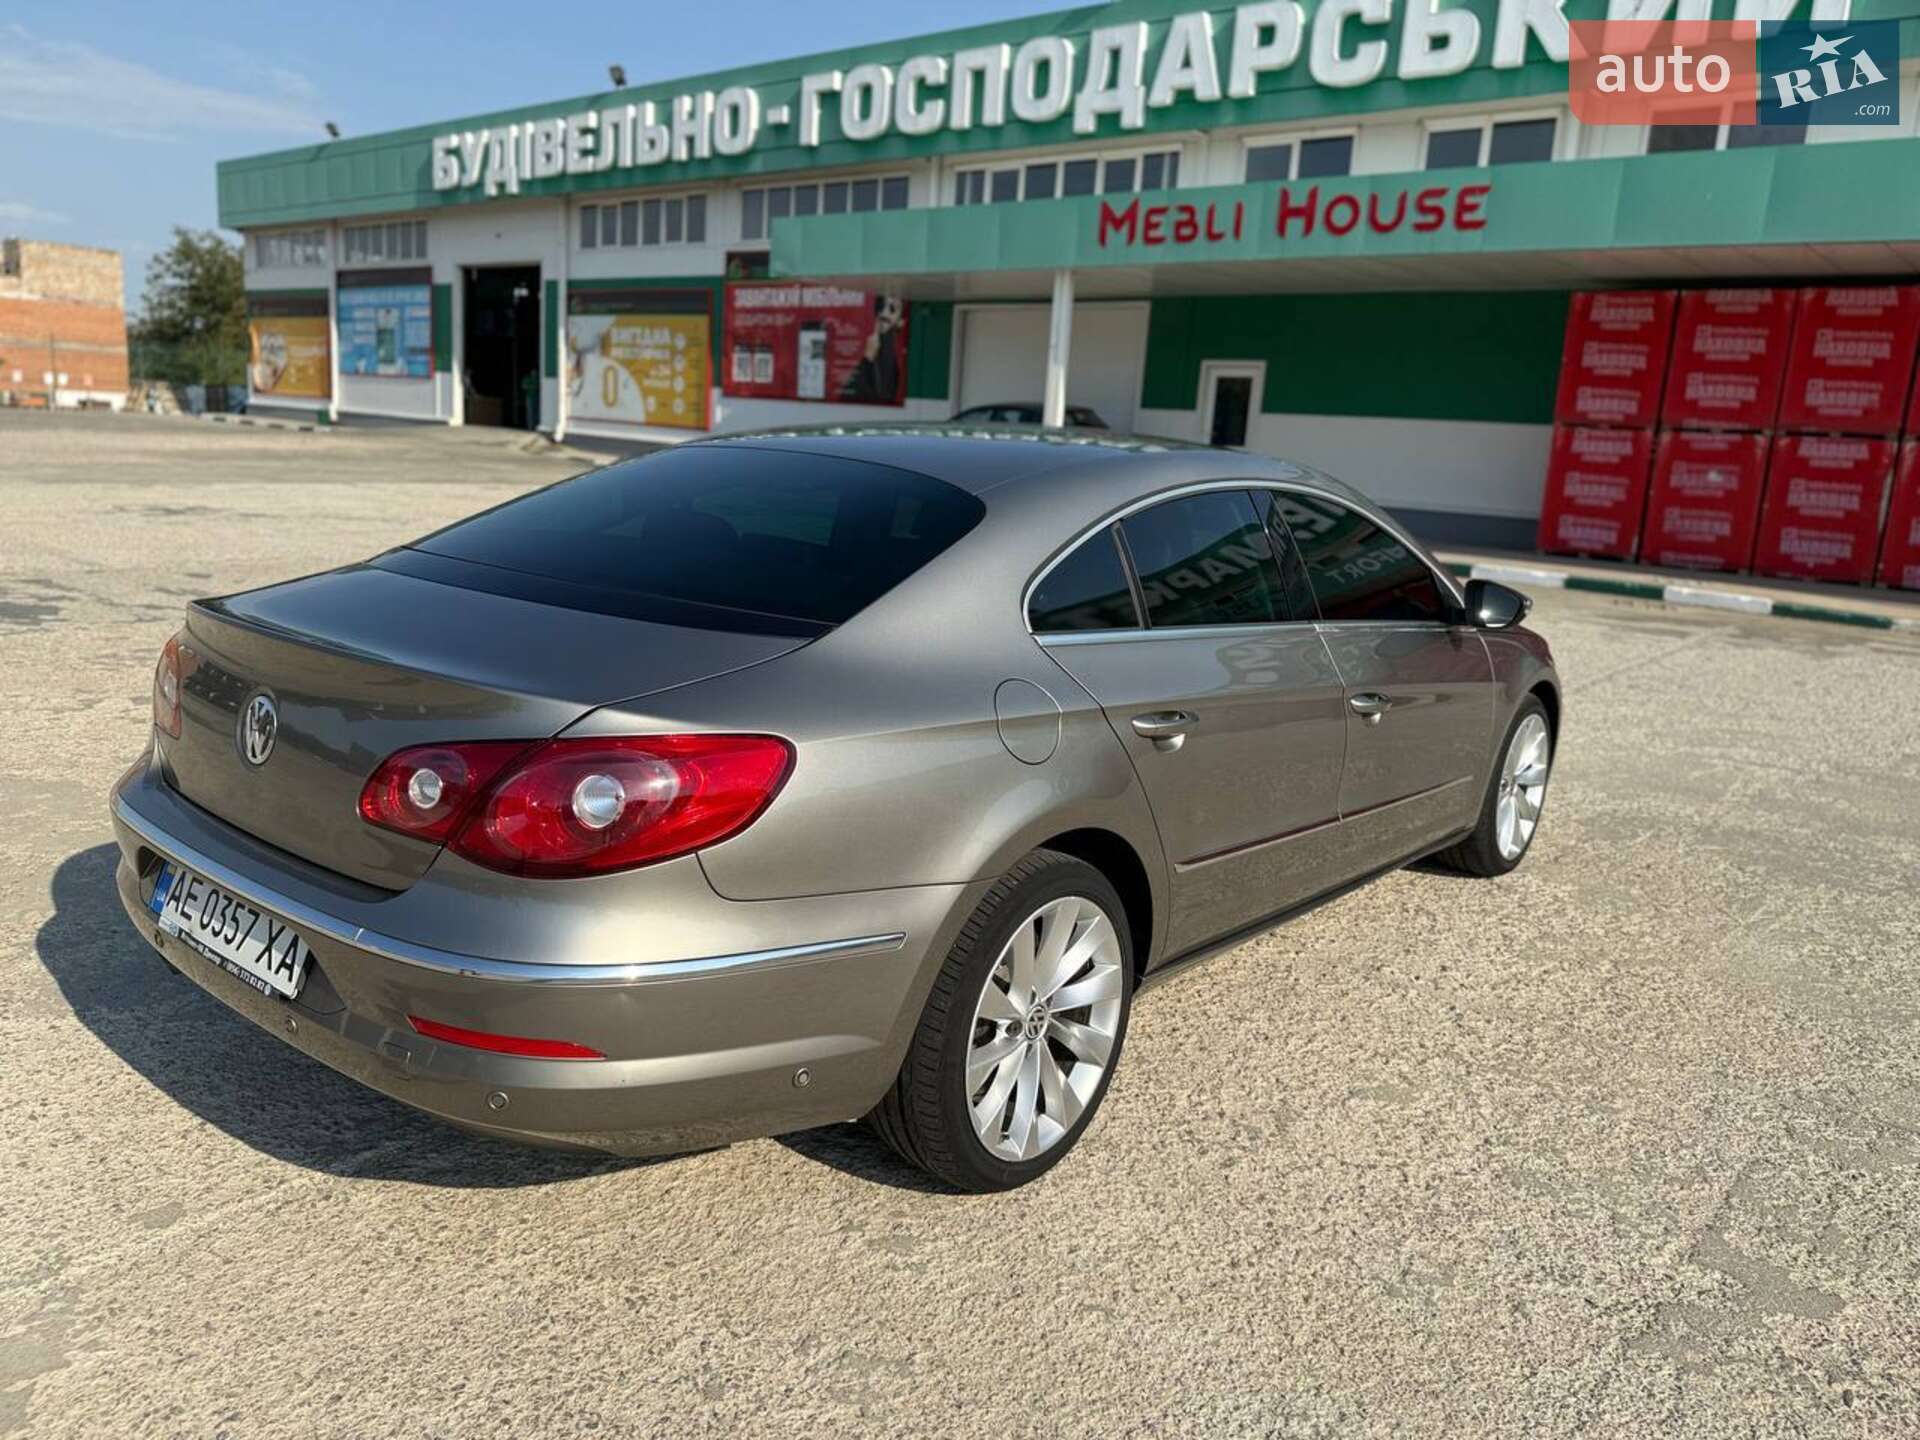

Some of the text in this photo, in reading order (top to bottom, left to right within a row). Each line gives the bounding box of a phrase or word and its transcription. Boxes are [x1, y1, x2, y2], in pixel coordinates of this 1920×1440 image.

[431, 0, 1848, 196] БУДІВЕЛЬНО-ГОСПОДАРСЬК
[1276, 184, 1492, 239] HOUSE
[166, 871, 204, 921] AE
[200, 888, 260, 952] 0357
[254, 918, 300, 983] XA
